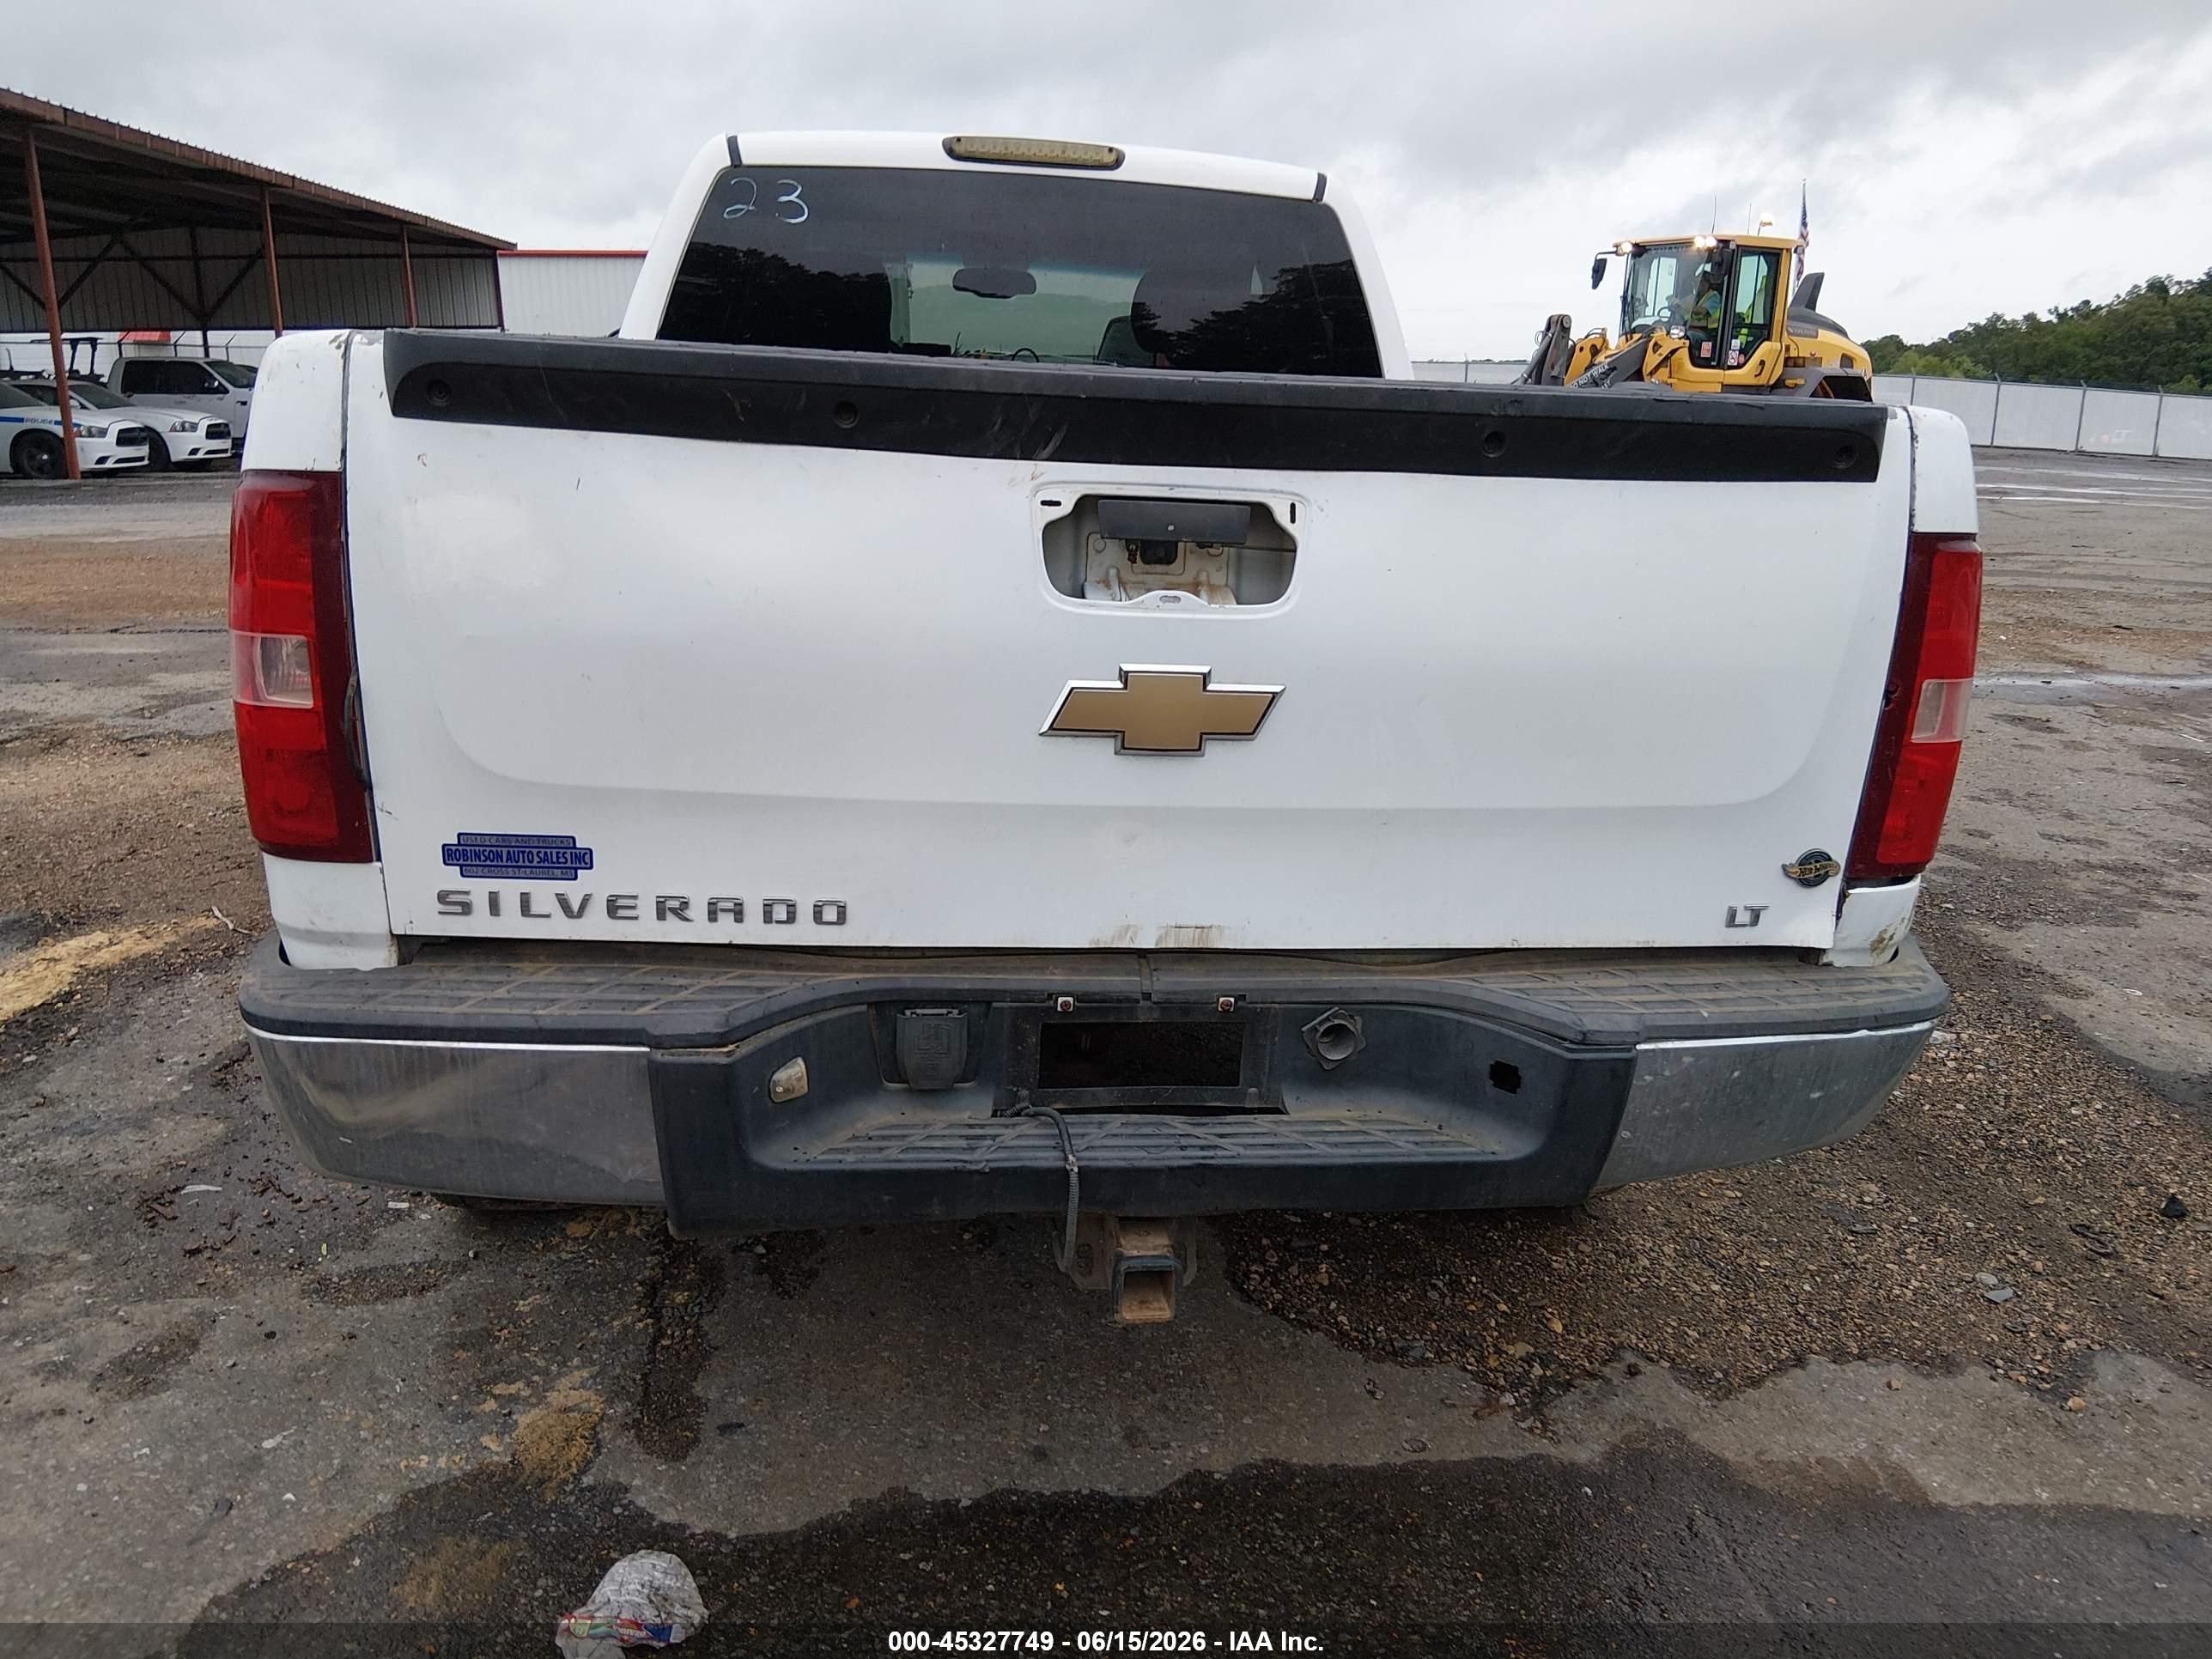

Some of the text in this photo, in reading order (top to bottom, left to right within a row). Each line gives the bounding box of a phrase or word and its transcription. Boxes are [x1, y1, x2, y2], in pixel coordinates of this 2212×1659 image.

[1591, 363, 1608, 379] WALK
[538, 837, 571, 846] TRUCKS
[447, 848, 589, 866] ROBINSON AUTO SALES INC
[436, 889, 848, 926] SILVERADO
[1725, 904, 1770, 927] LT
